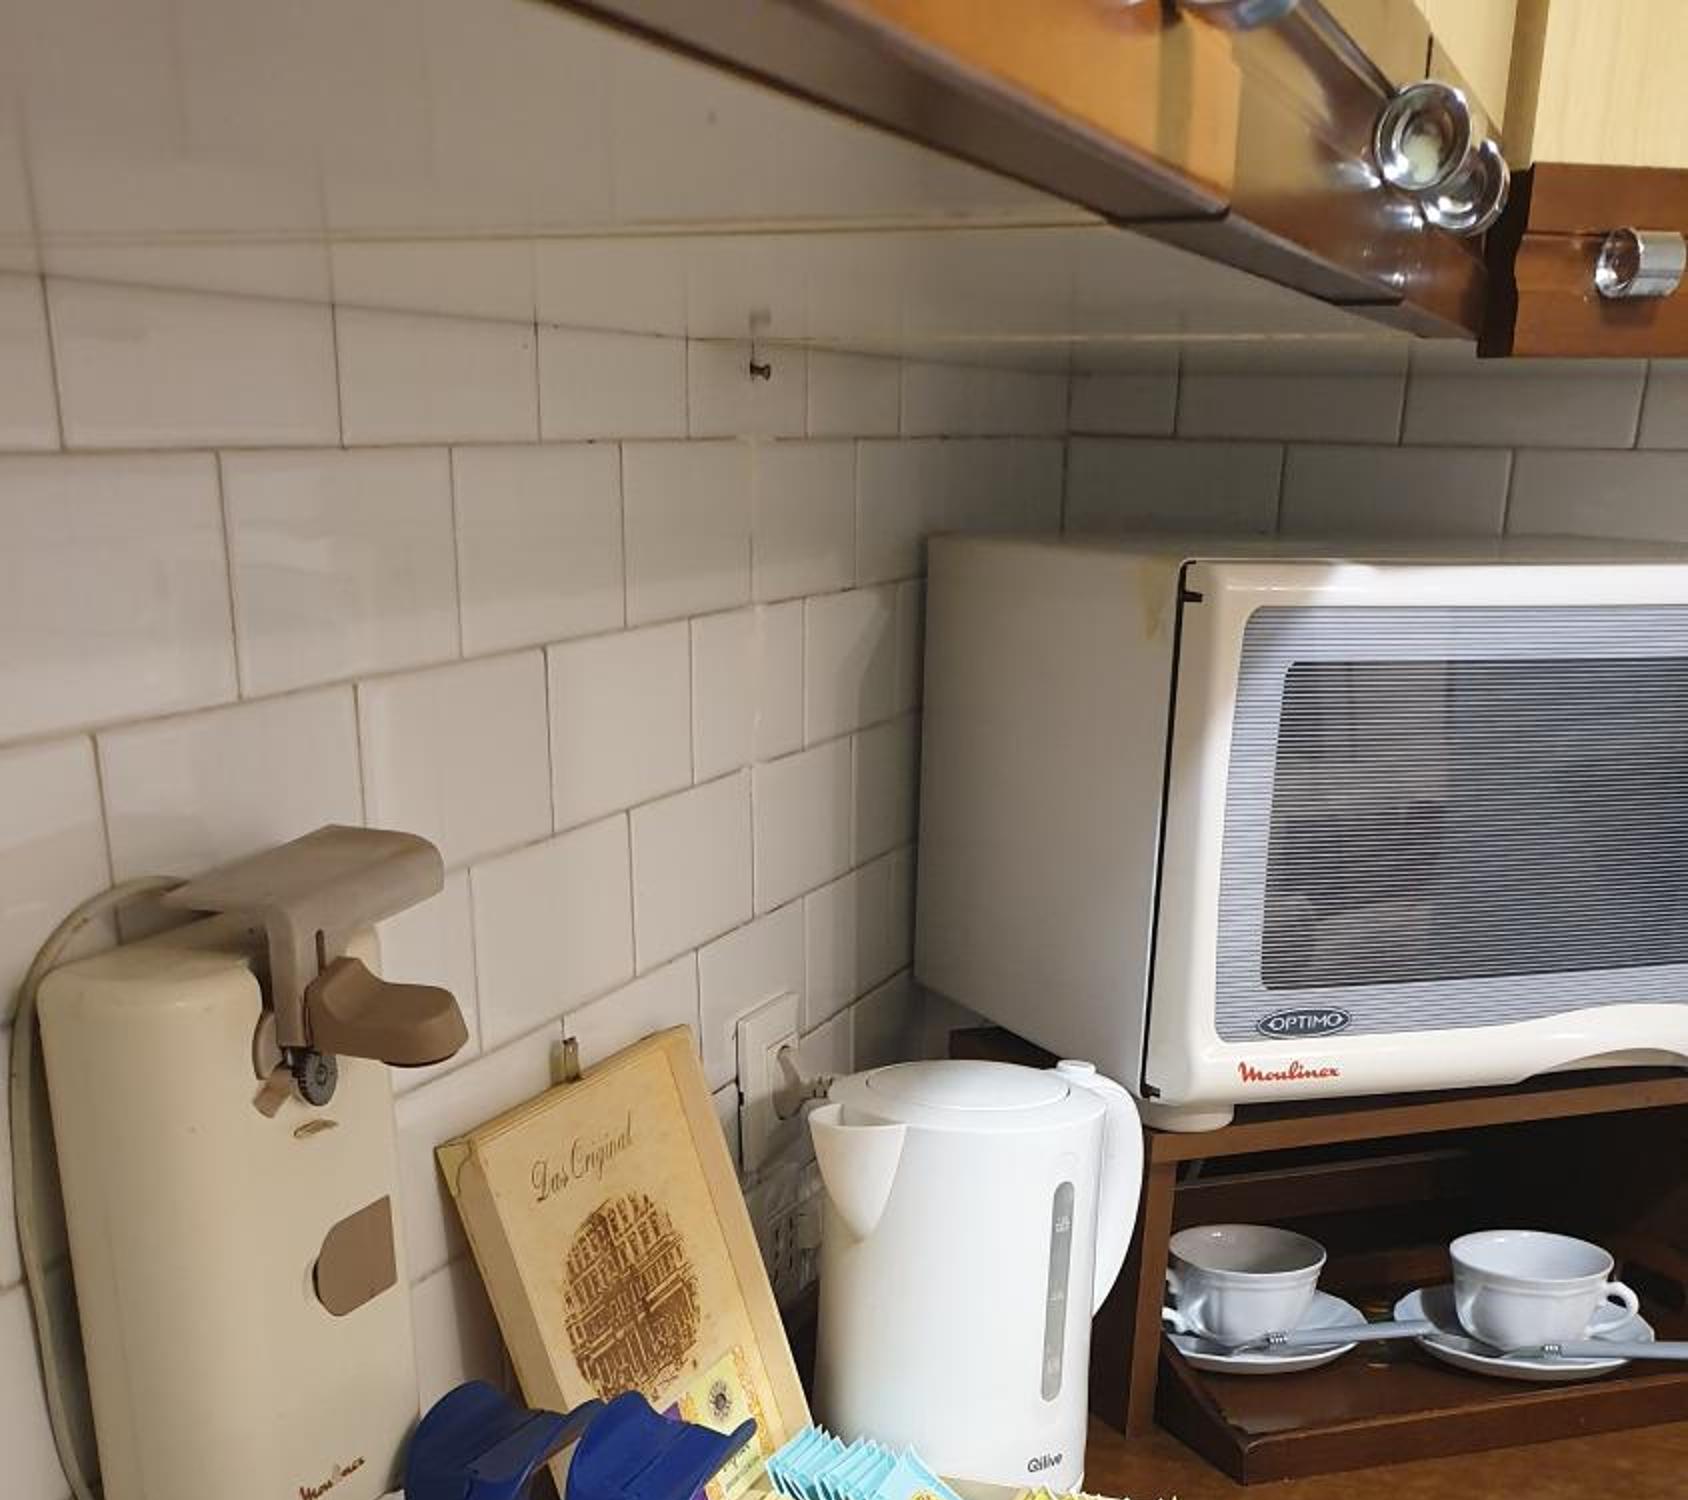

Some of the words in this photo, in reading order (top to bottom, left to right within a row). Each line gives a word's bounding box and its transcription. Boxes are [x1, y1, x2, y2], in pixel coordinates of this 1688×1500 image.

[1267, 1012, 1344, 1032] OPTIMO
[1237, 1058, 1341, 1083] Moulinex
[531, 1160, 569, 1202] Das
[570, 1108, 632, 1182] Original
[1027, 1453, 1063, 1473] Qilive
